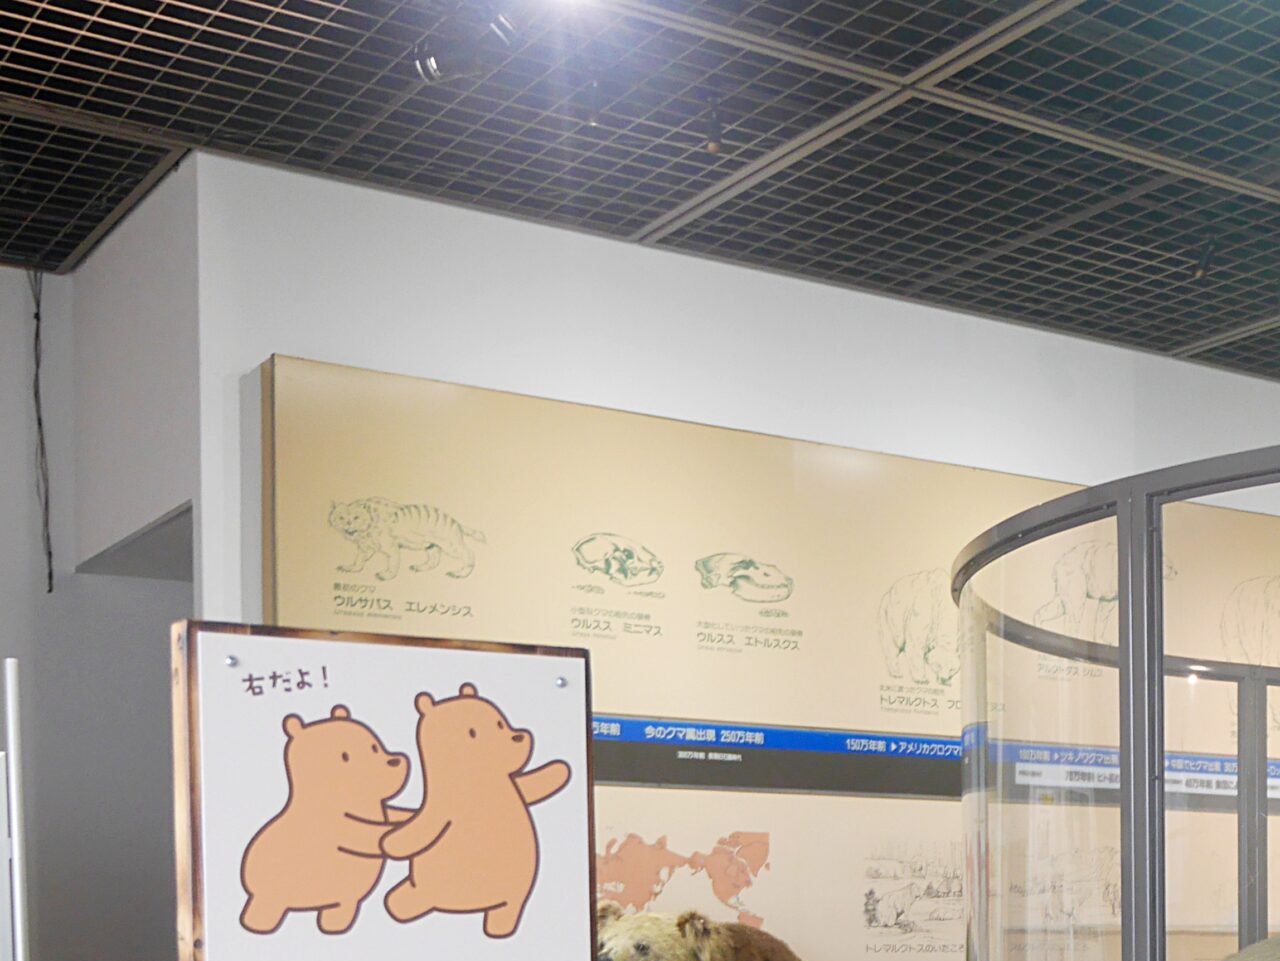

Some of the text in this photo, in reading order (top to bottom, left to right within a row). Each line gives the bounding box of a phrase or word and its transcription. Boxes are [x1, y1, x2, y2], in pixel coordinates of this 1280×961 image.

[405, 601, 473, 617] エレメンシス
[571, 618, 612, 632] ウルスス
[623, 622, 663, 637] ミニマス
[242, 666, 328, 696] 右だよ!
[880, 695, 939, 709] トレマルクトス
[898, 742, 962, 756] アメリカクログマ
